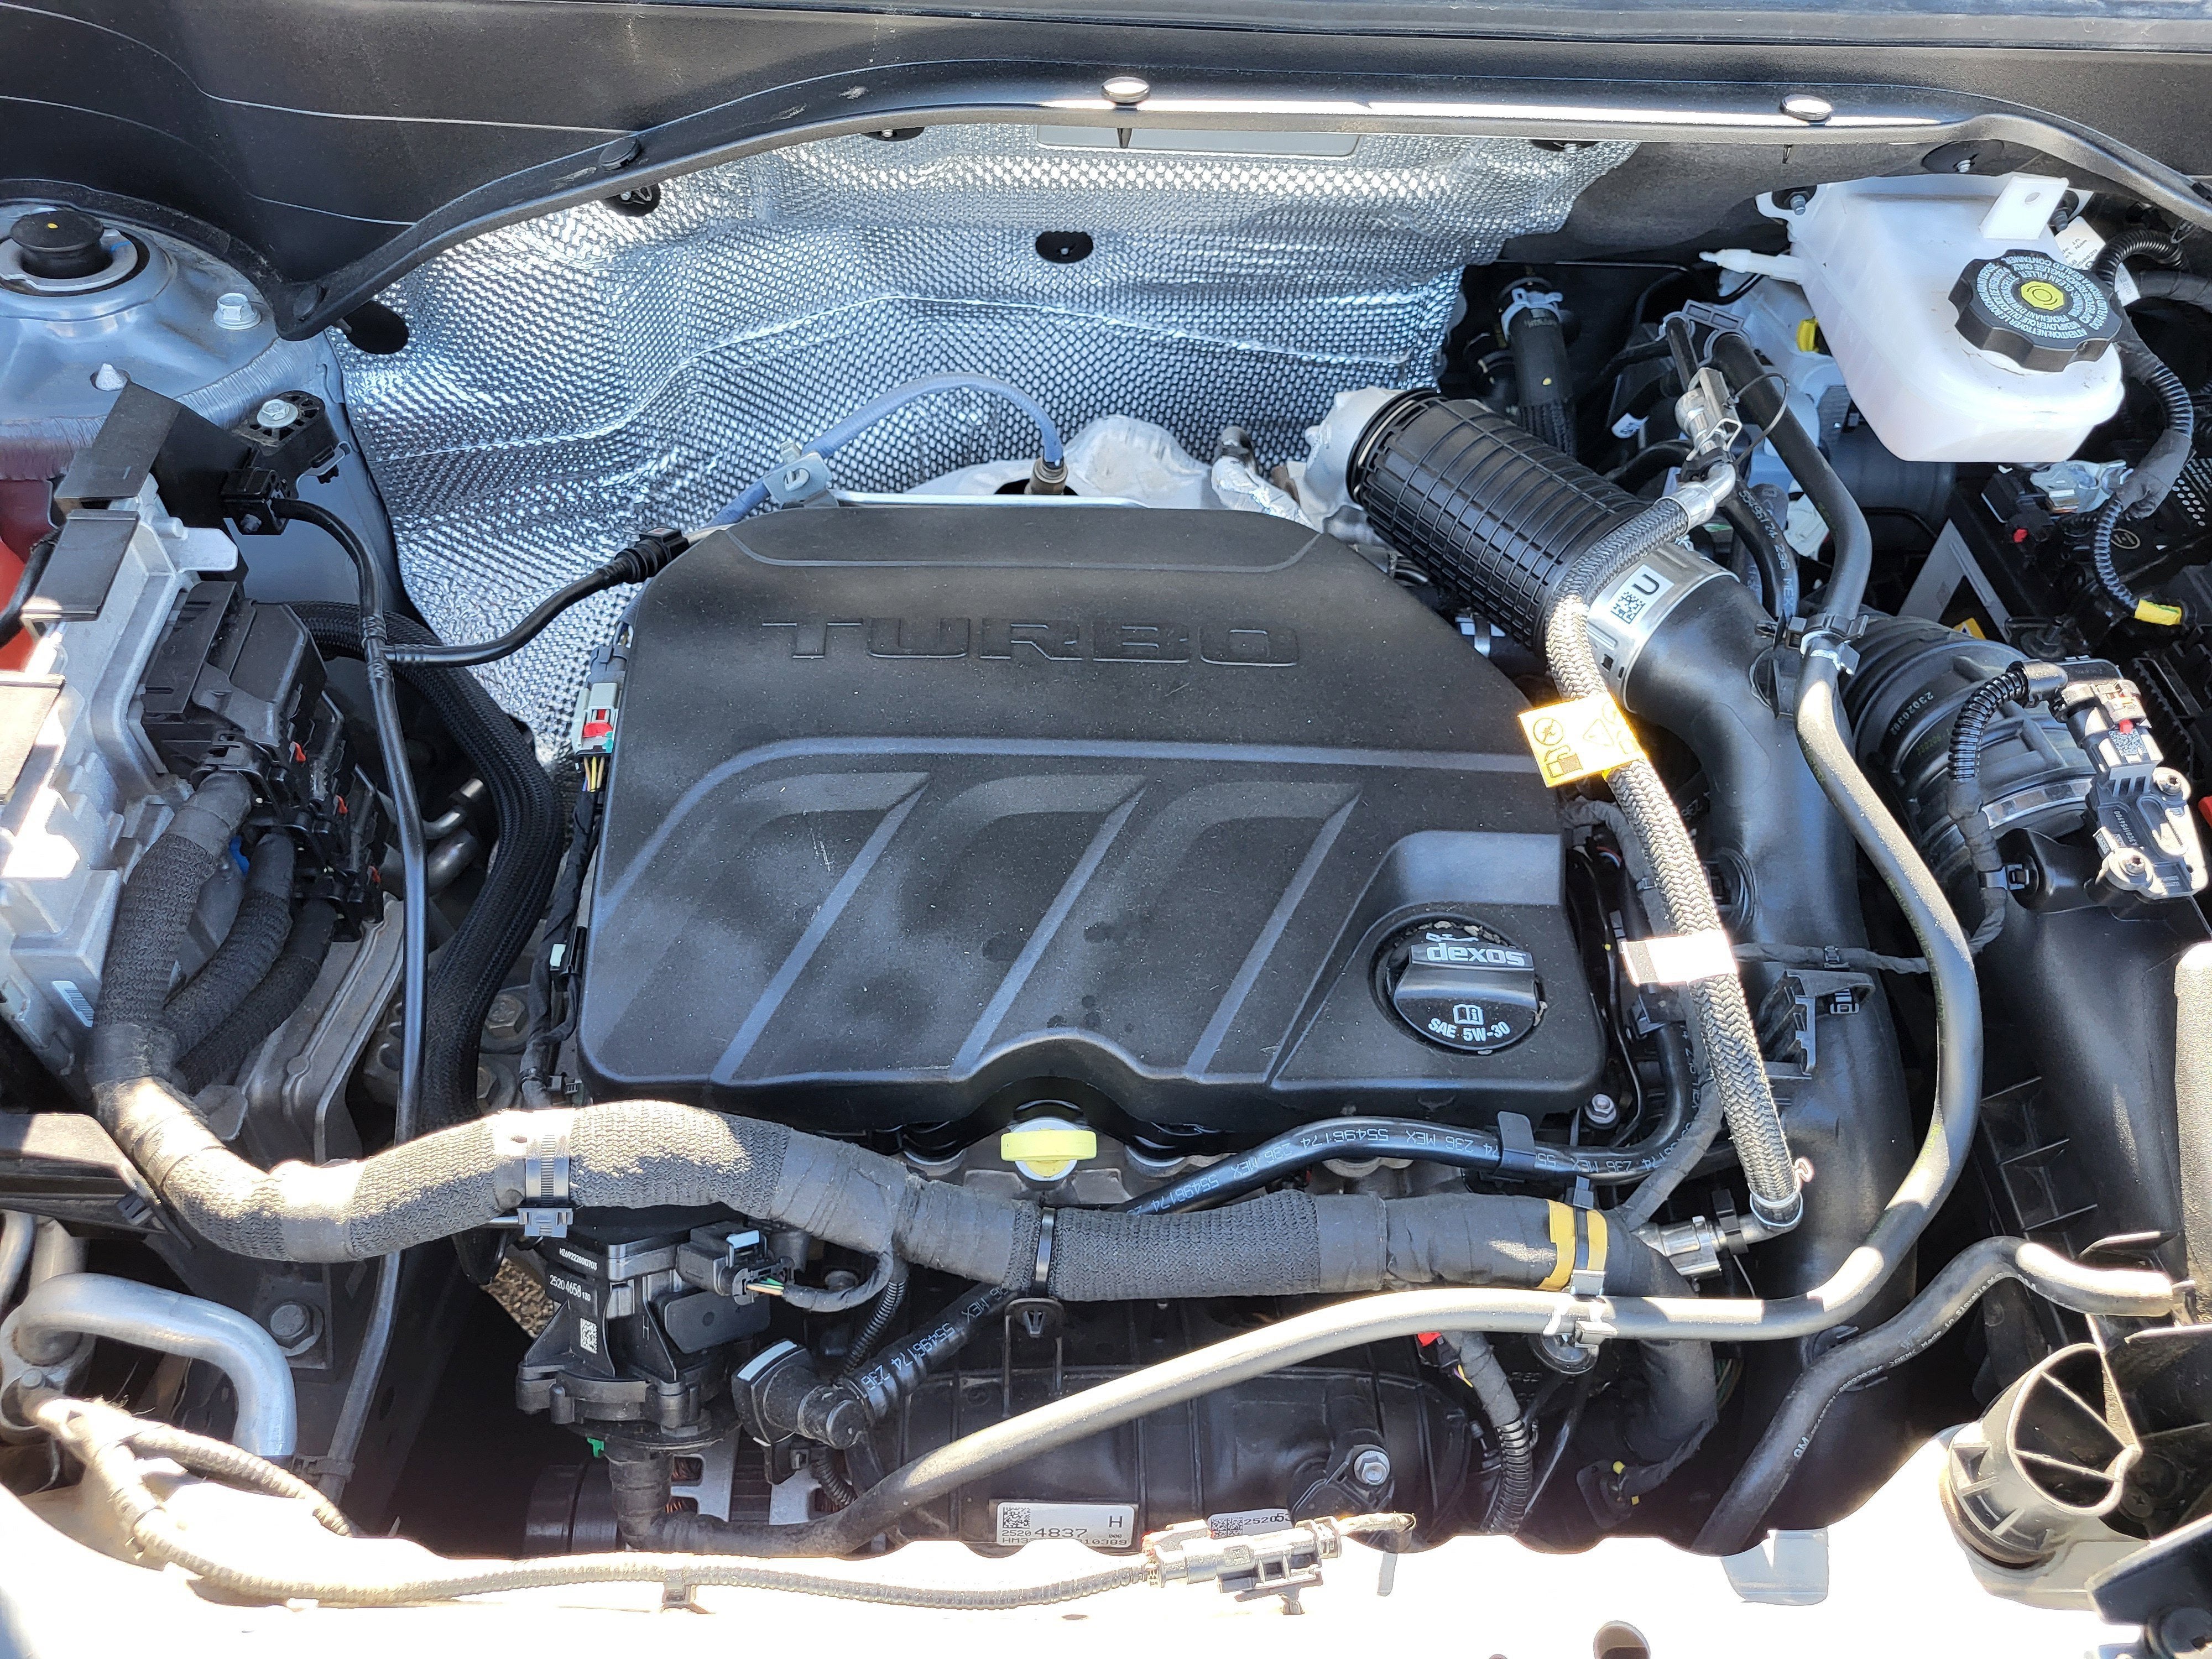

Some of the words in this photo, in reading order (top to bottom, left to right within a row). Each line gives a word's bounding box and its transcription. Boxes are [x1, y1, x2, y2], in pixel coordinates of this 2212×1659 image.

[2008, 262, 2034, 272] ONLY
[2016, 270, 2048, 280] FILLER
[2032, 263, 2051, 273] USE
[2051, 261, 2087, 281] SEALED
[2047, 274, 2077, 292] CLEAN
[1996, 313, 2012, 322] LE
[2007, 310, 2023, 320] DU
[2018, 315, 2037, 327] QUE
[2023, 310, 2072, 323] PROVENANT
[2077, 311, 2095, 324] CAP
[2006, 318, 2047, 337] NETTOYER
[1775, 544, 1790, 570] 236
[1632, 573, 1660, 595] U
[1782, 577, 1794, 607] MEX
[761, 618, 1300, 667] TURBO
[1426, 942, 1526, 967] dexos
[1428, 1017, 1457, 1039] SAE
[1463, 1020, 1511, 1042] 5W-30
[1300, 1128, 1389, 1150] 55496174
[1405, 1130, 1436, 1147] MEX
[1445, 1135, 1474, 1153] 236
[1264, 1142, 1293, 1165] 236
[1231, 1156, 1260, 1178] MEX
[1571, 1157, 1600, 1173] MEX
[1605, 1160, 1635, 1173] 236
[1151, 1173, 1220, 1212] 55496174
[549, 1274, 566, 1291] 2520
[565, 1280, 582, 1298] 4658
[582, 1291, 591, 1302] 130
[961, 1297, 990, 1322] MEX
[1921, 1330, 1942, 1349] Made
[1944, 1318, 1955, 1328] in
[1955, 1285, 1987, 1317] Slovakia
[642, 1315, 650, 1340] H
[890, 1322, 956, 1371] 55496174
[860, 1364, 890, 1391] 236
[1109, 1515, 1123, 1528] H
[1034, 1527, 1088, 1538] 4837
